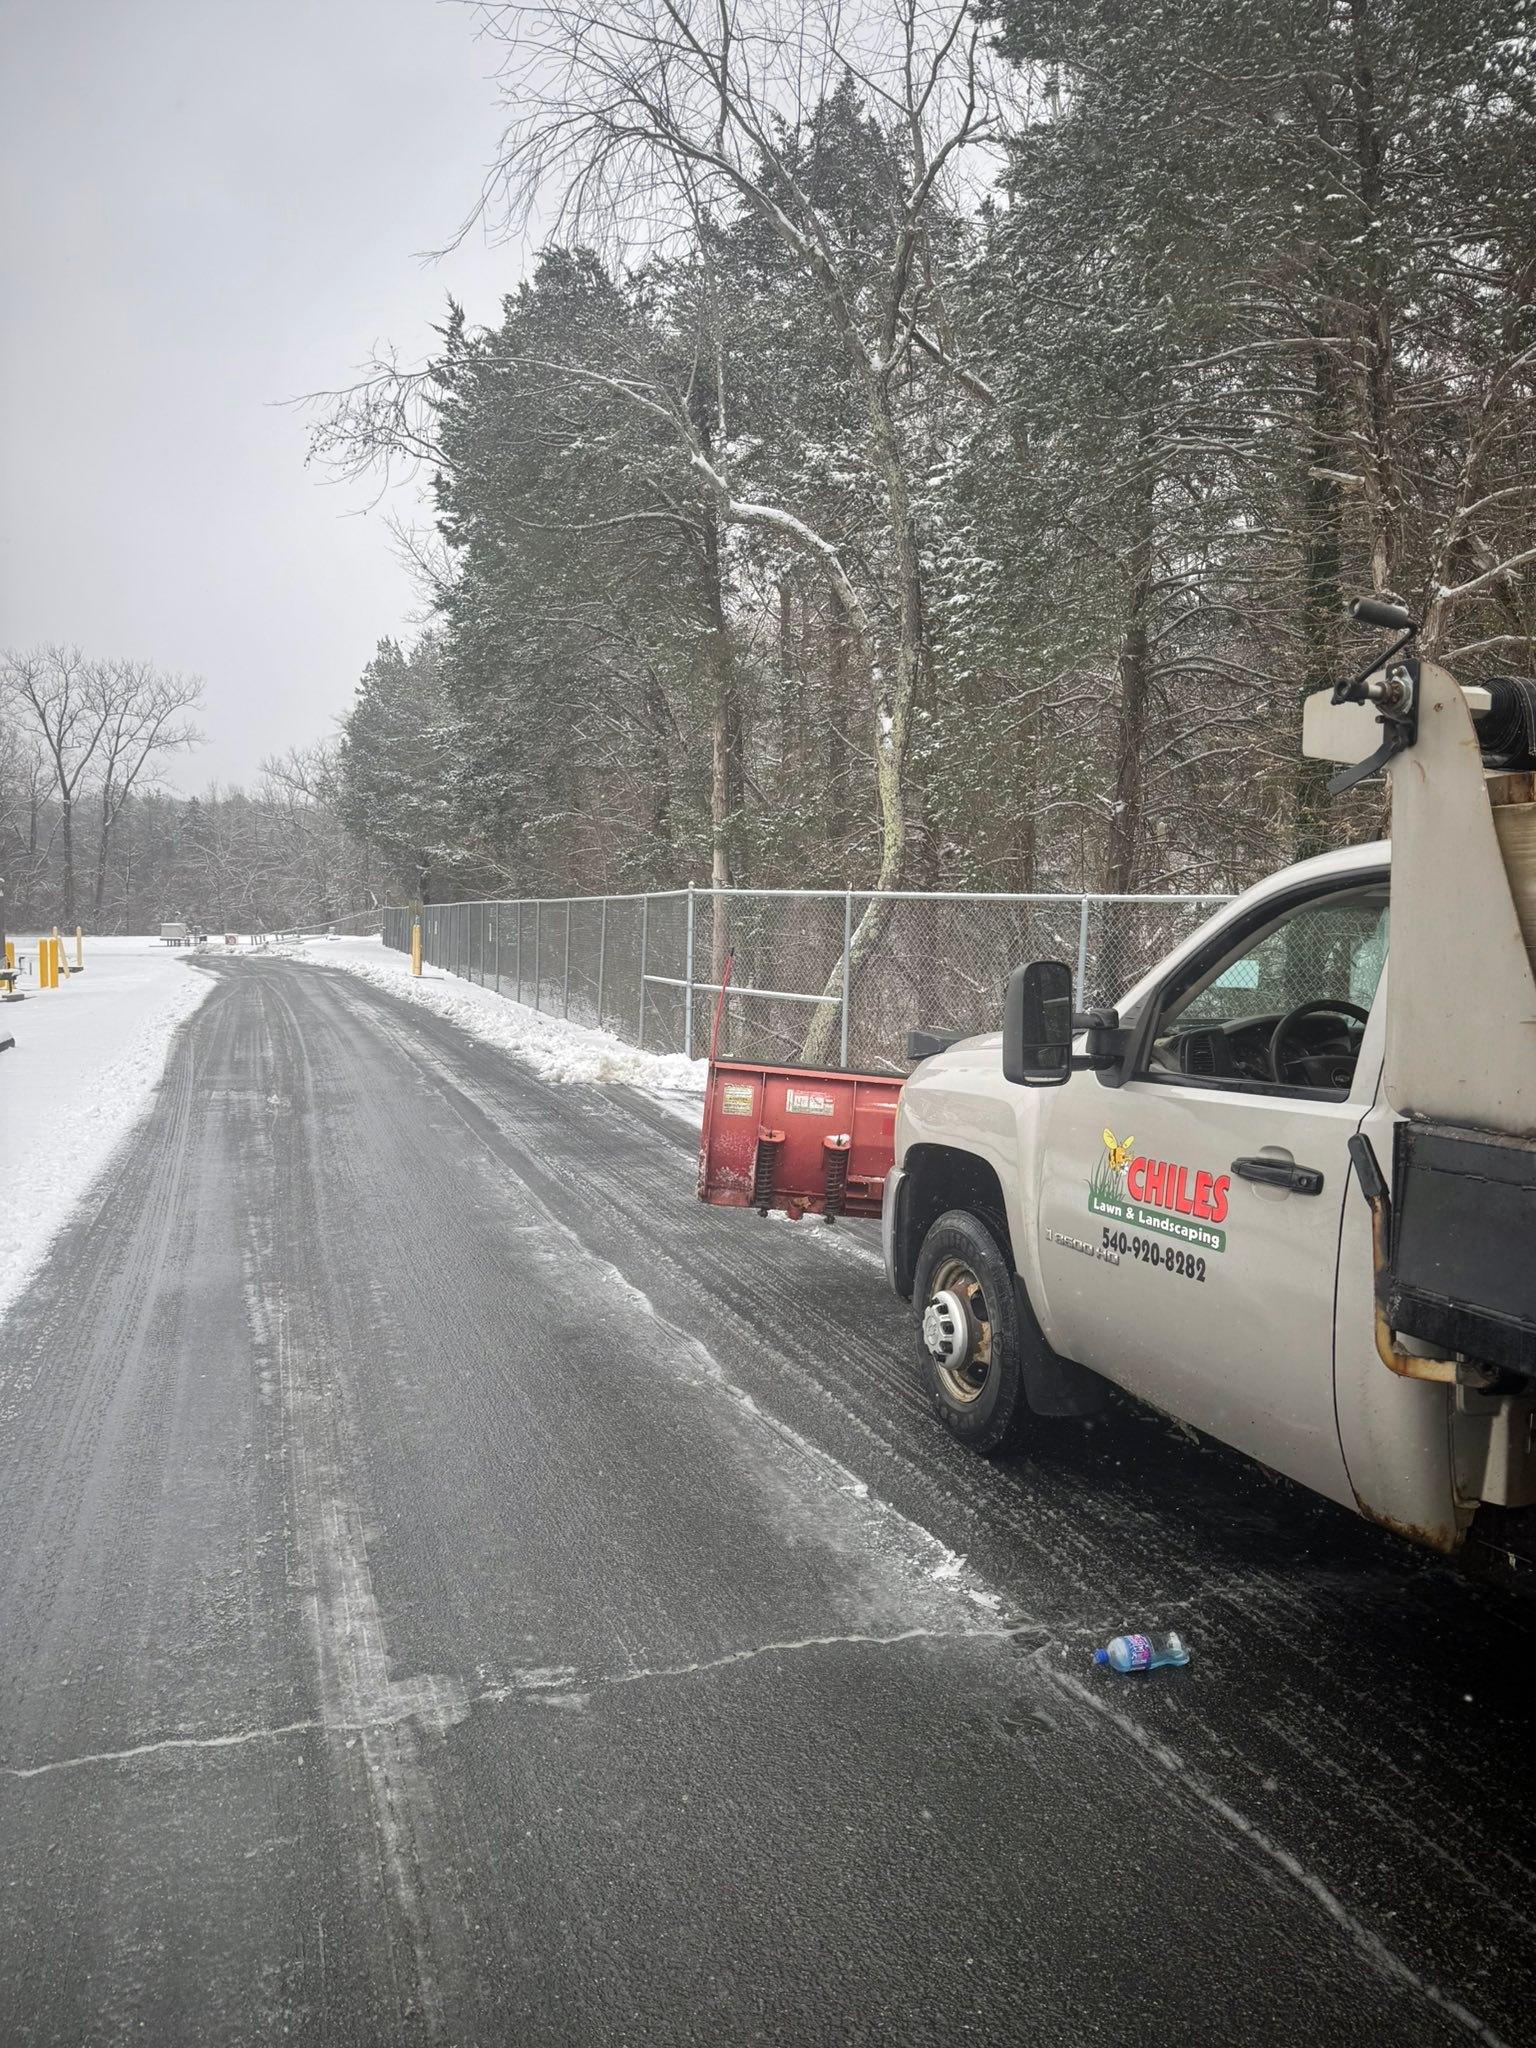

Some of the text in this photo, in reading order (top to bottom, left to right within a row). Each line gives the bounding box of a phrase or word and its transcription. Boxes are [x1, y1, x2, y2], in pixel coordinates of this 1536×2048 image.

[1127, 1156, 1231, 1224] CHILES
[1093, 1197, 1220, 1249] Lawn & Landscaping
[1102, 1226, 1207, 1282] 540-920-8282
